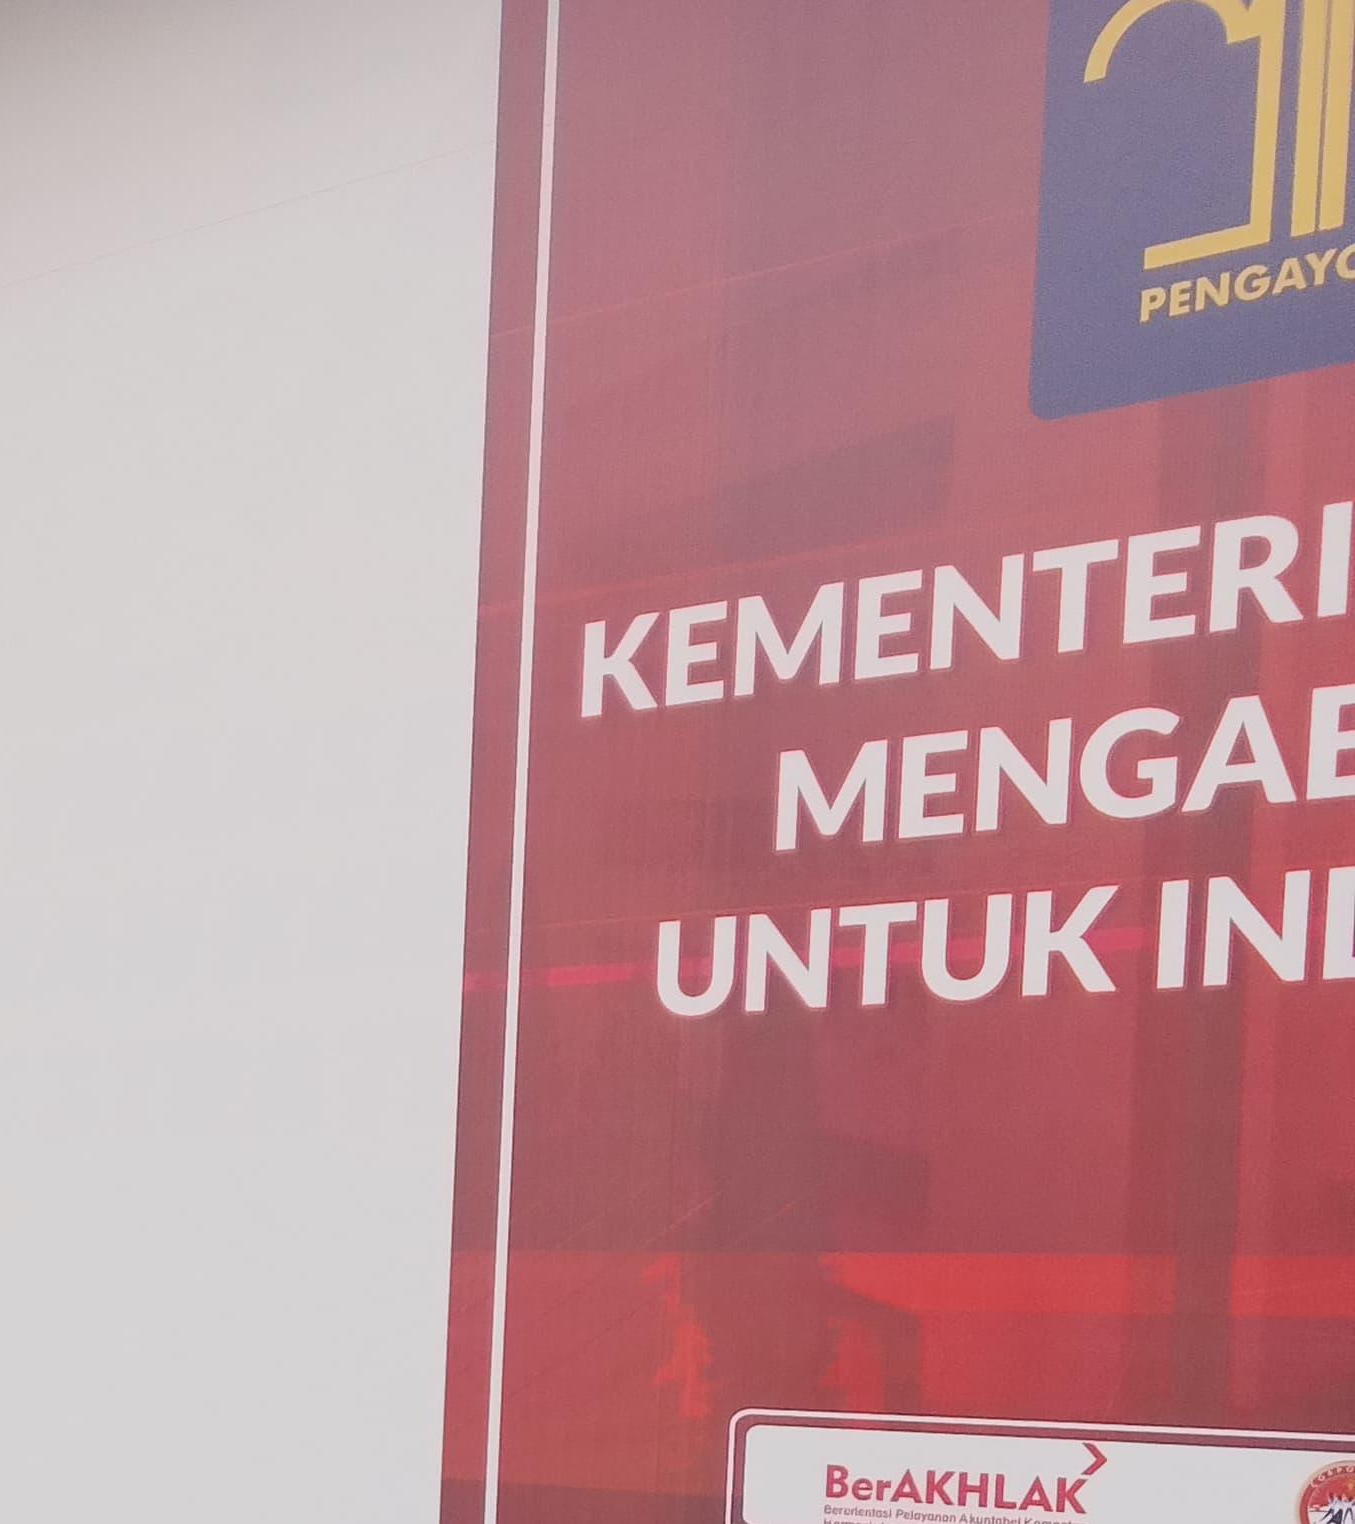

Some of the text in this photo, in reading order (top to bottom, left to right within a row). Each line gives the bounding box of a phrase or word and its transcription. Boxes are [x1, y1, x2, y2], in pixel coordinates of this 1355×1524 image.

[656, 885, 1120, 1017] UNTUK
[824, 1504, 892, 1519] Berorientasi
[895, 1508, 957, 1523] Pelayanan
[825, 1464, 1090, 1515] BerAKHLAK
